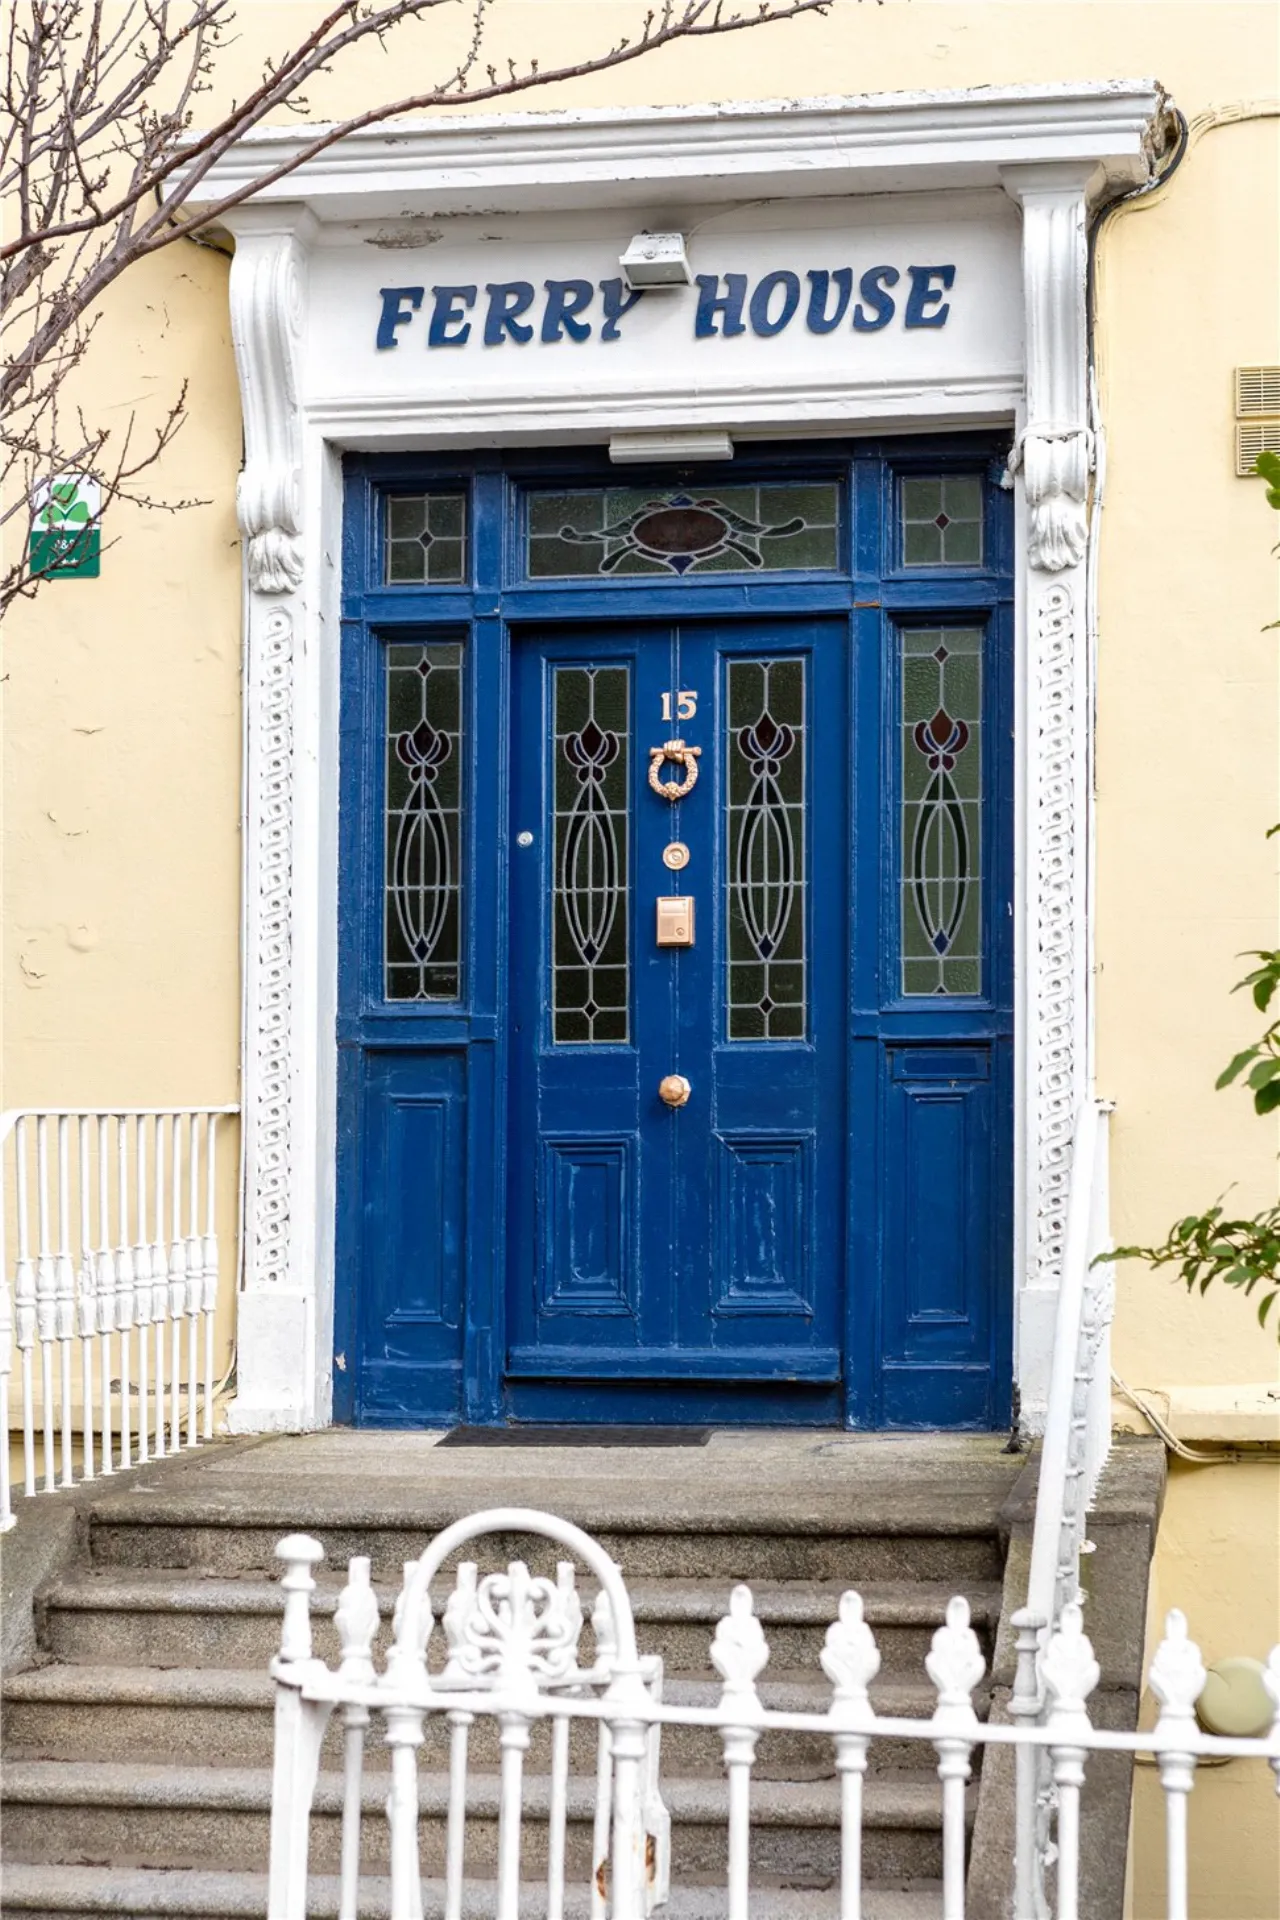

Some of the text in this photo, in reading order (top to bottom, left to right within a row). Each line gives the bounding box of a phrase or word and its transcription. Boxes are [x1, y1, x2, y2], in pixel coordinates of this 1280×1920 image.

[375, 264, 957, 349] FERRY HOUSE
[660, 691, 699, 721] 15
